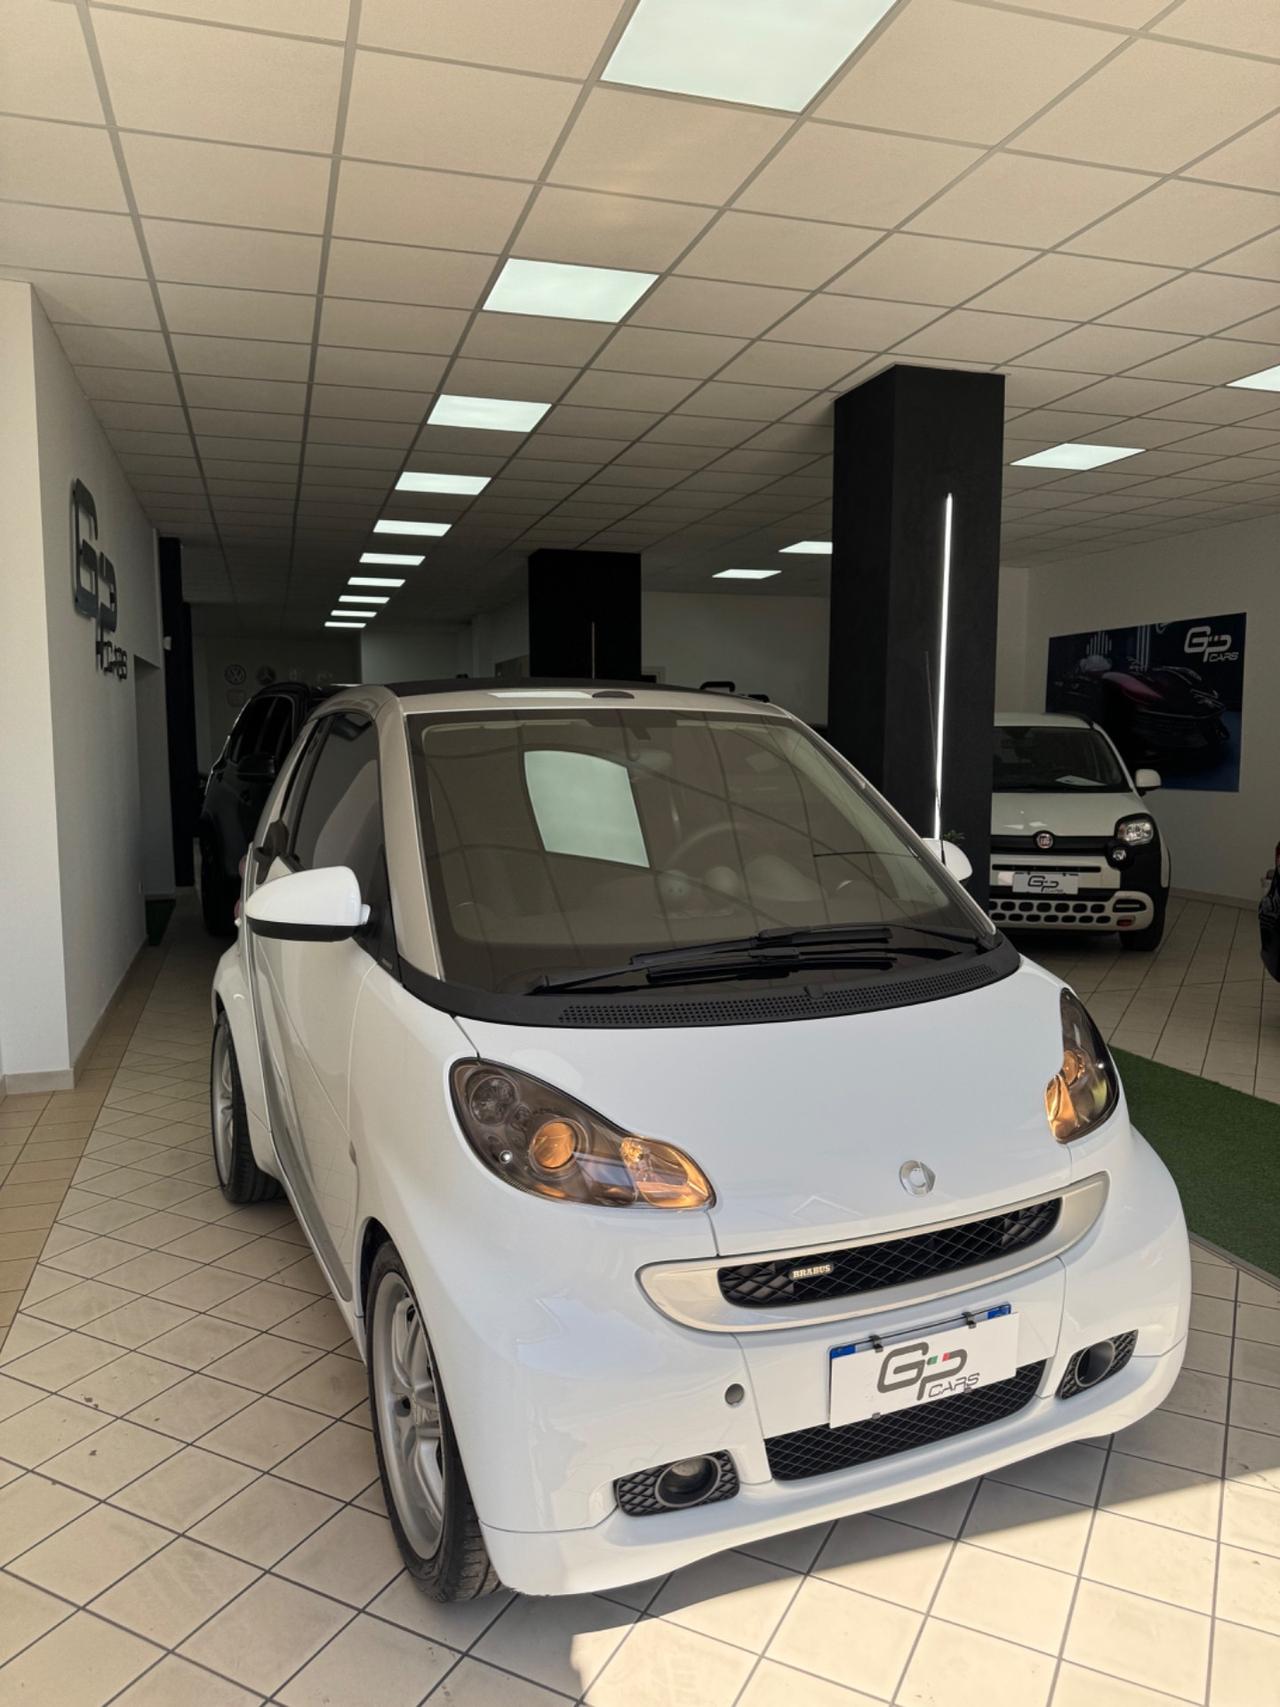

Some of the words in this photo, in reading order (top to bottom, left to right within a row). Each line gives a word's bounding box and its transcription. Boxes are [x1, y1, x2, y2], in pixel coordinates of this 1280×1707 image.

[1184, 625, 1232, 662] GP
[1209, 651, 1240, 663] CARS
[1028, 875, 1059, 893] GP
[792, 1264, 831, 1278] BRABUS
[877, 1341, 968, 1401] GP
[928, 1372, 980, 1399] CARS
